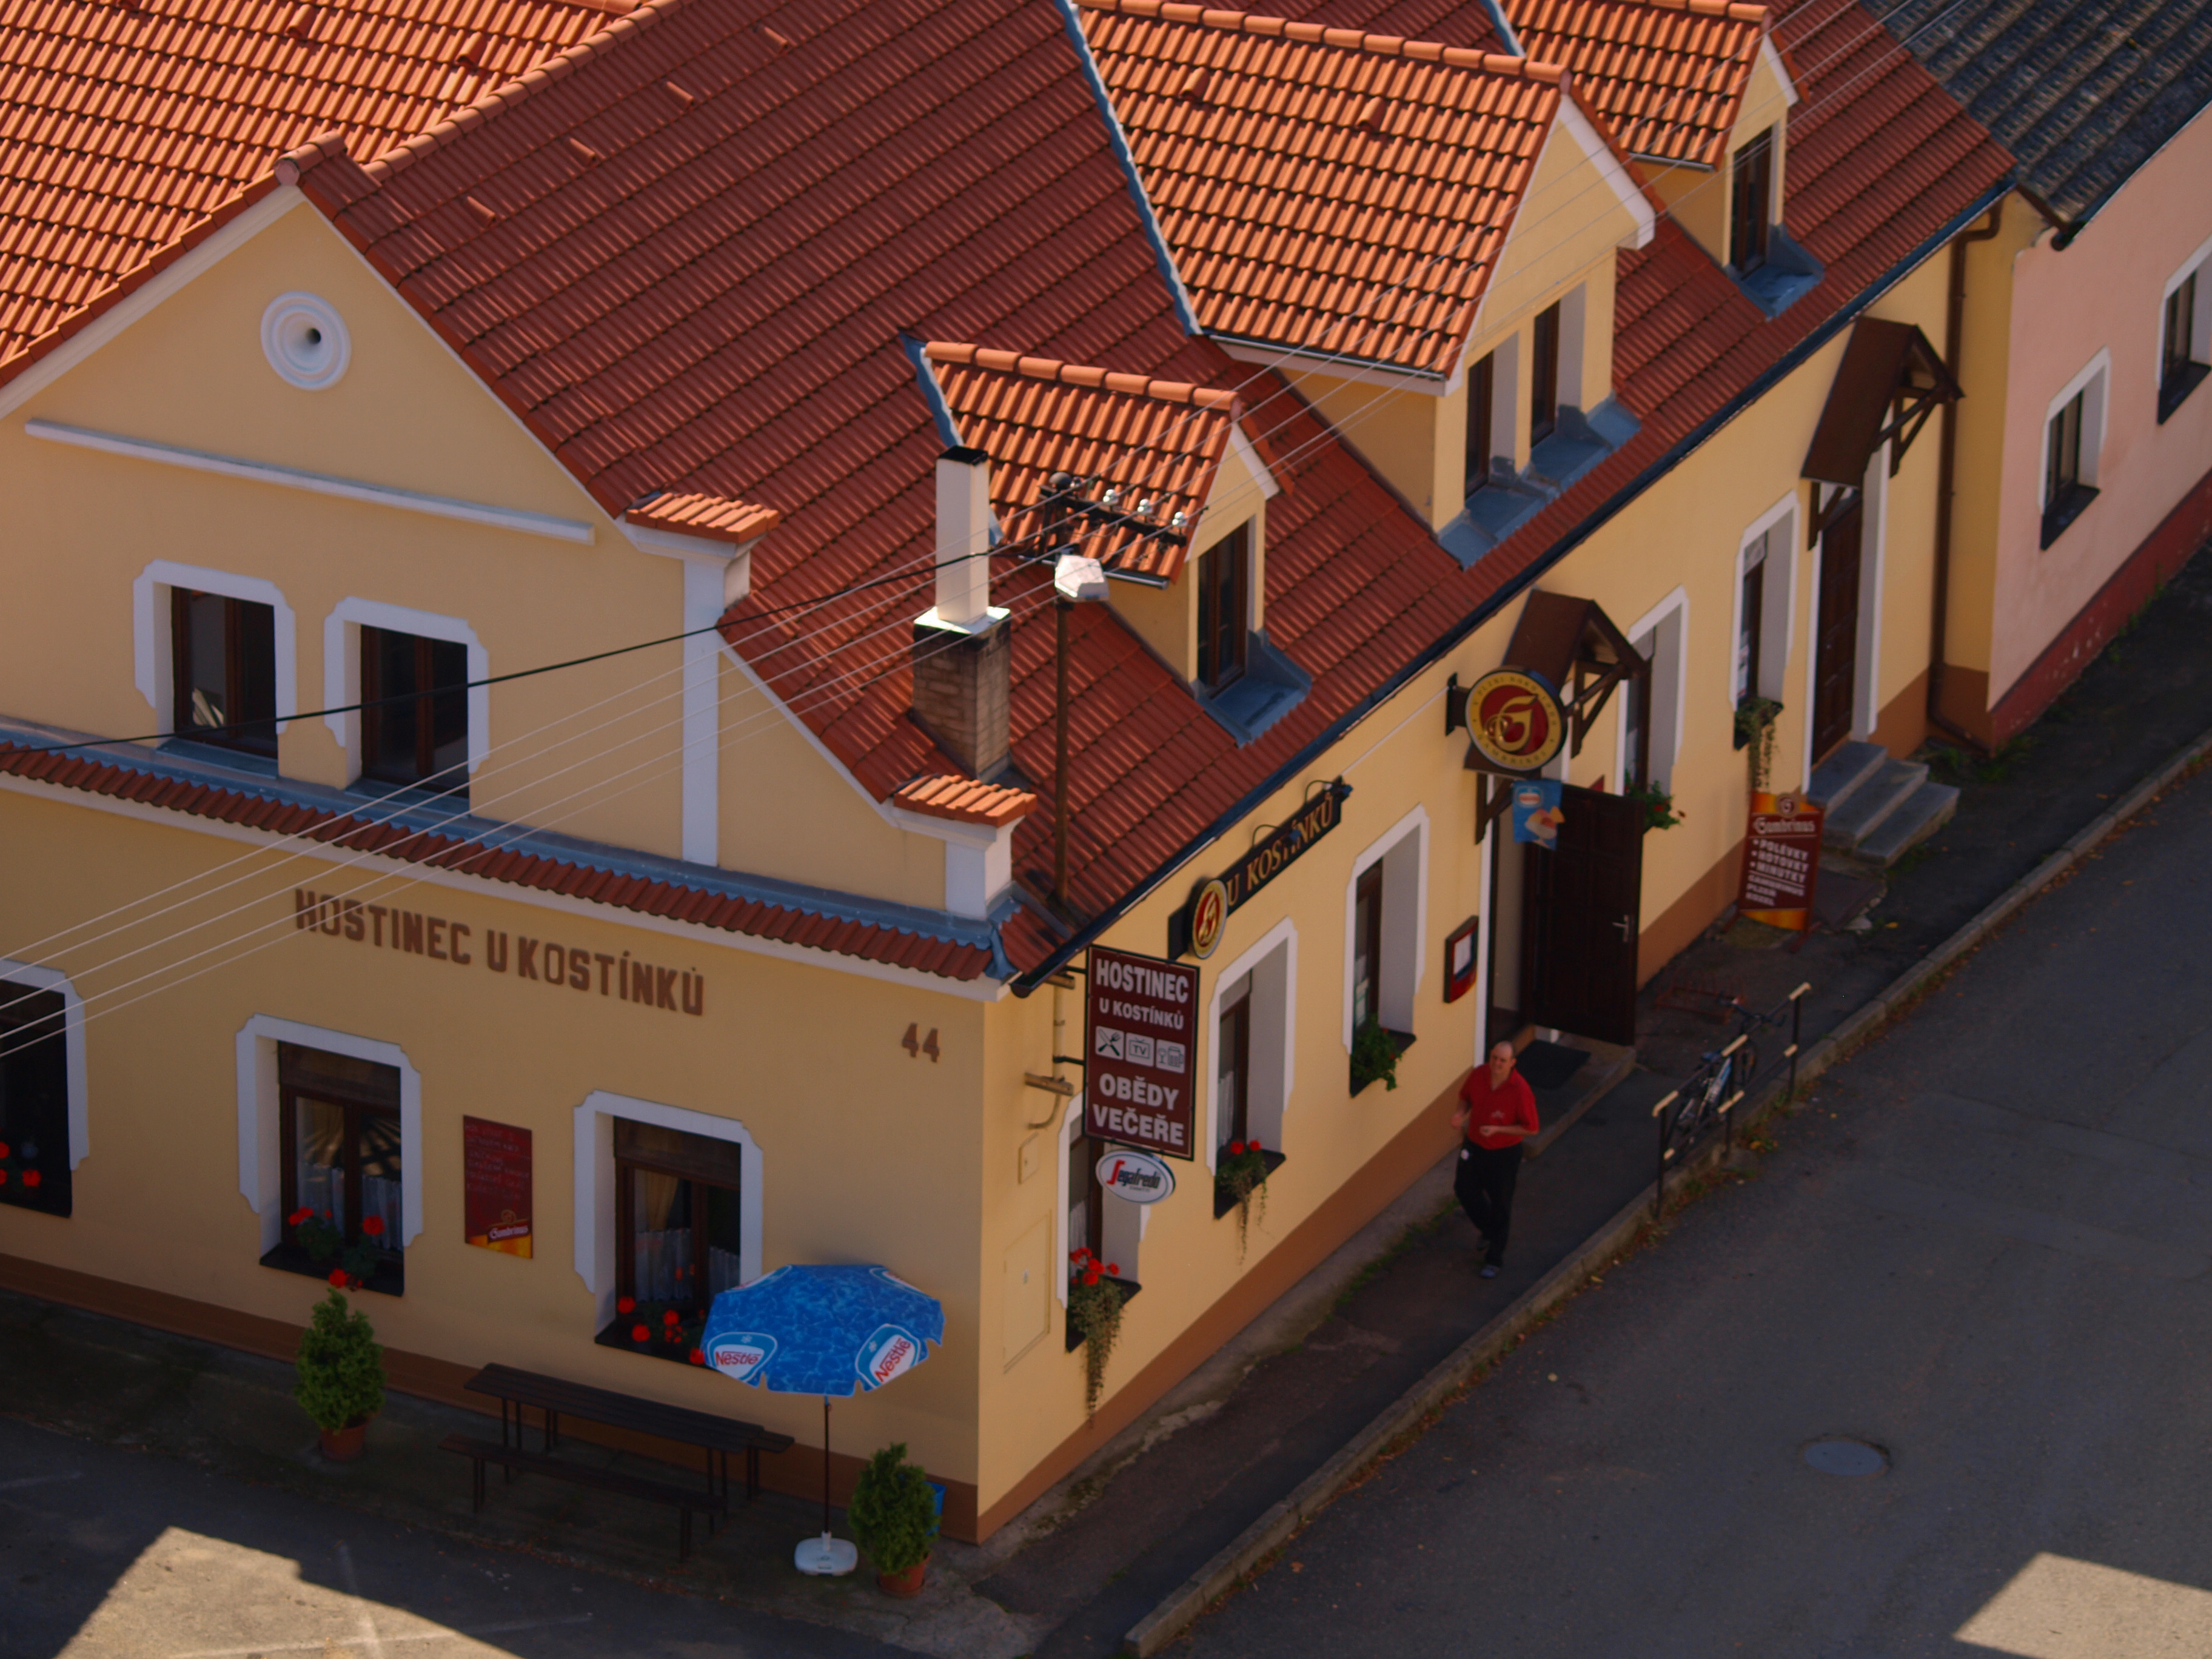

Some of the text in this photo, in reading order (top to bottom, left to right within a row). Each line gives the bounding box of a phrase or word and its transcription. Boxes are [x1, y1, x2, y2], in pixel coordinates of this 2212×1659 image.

[1753, 817, 1815, 834] Gambrinus
[1226, 873, 1239, 906] U
[295, 889, 703, 1016] HOSTINEC U KOSTÍNKŮ
[1096, 958, 1189, 1004] HOSTINEC
[1099, 997, 1184, 1030] U KOSTÍNKŮ
[902, 1022, 940, 1063] 44
[1133, 1044, 1147, 1055] TV
[1099, 1073, 1179, 1111] OBĚDY
[1093, 1104, 1184, 1146] VEČEŘE
